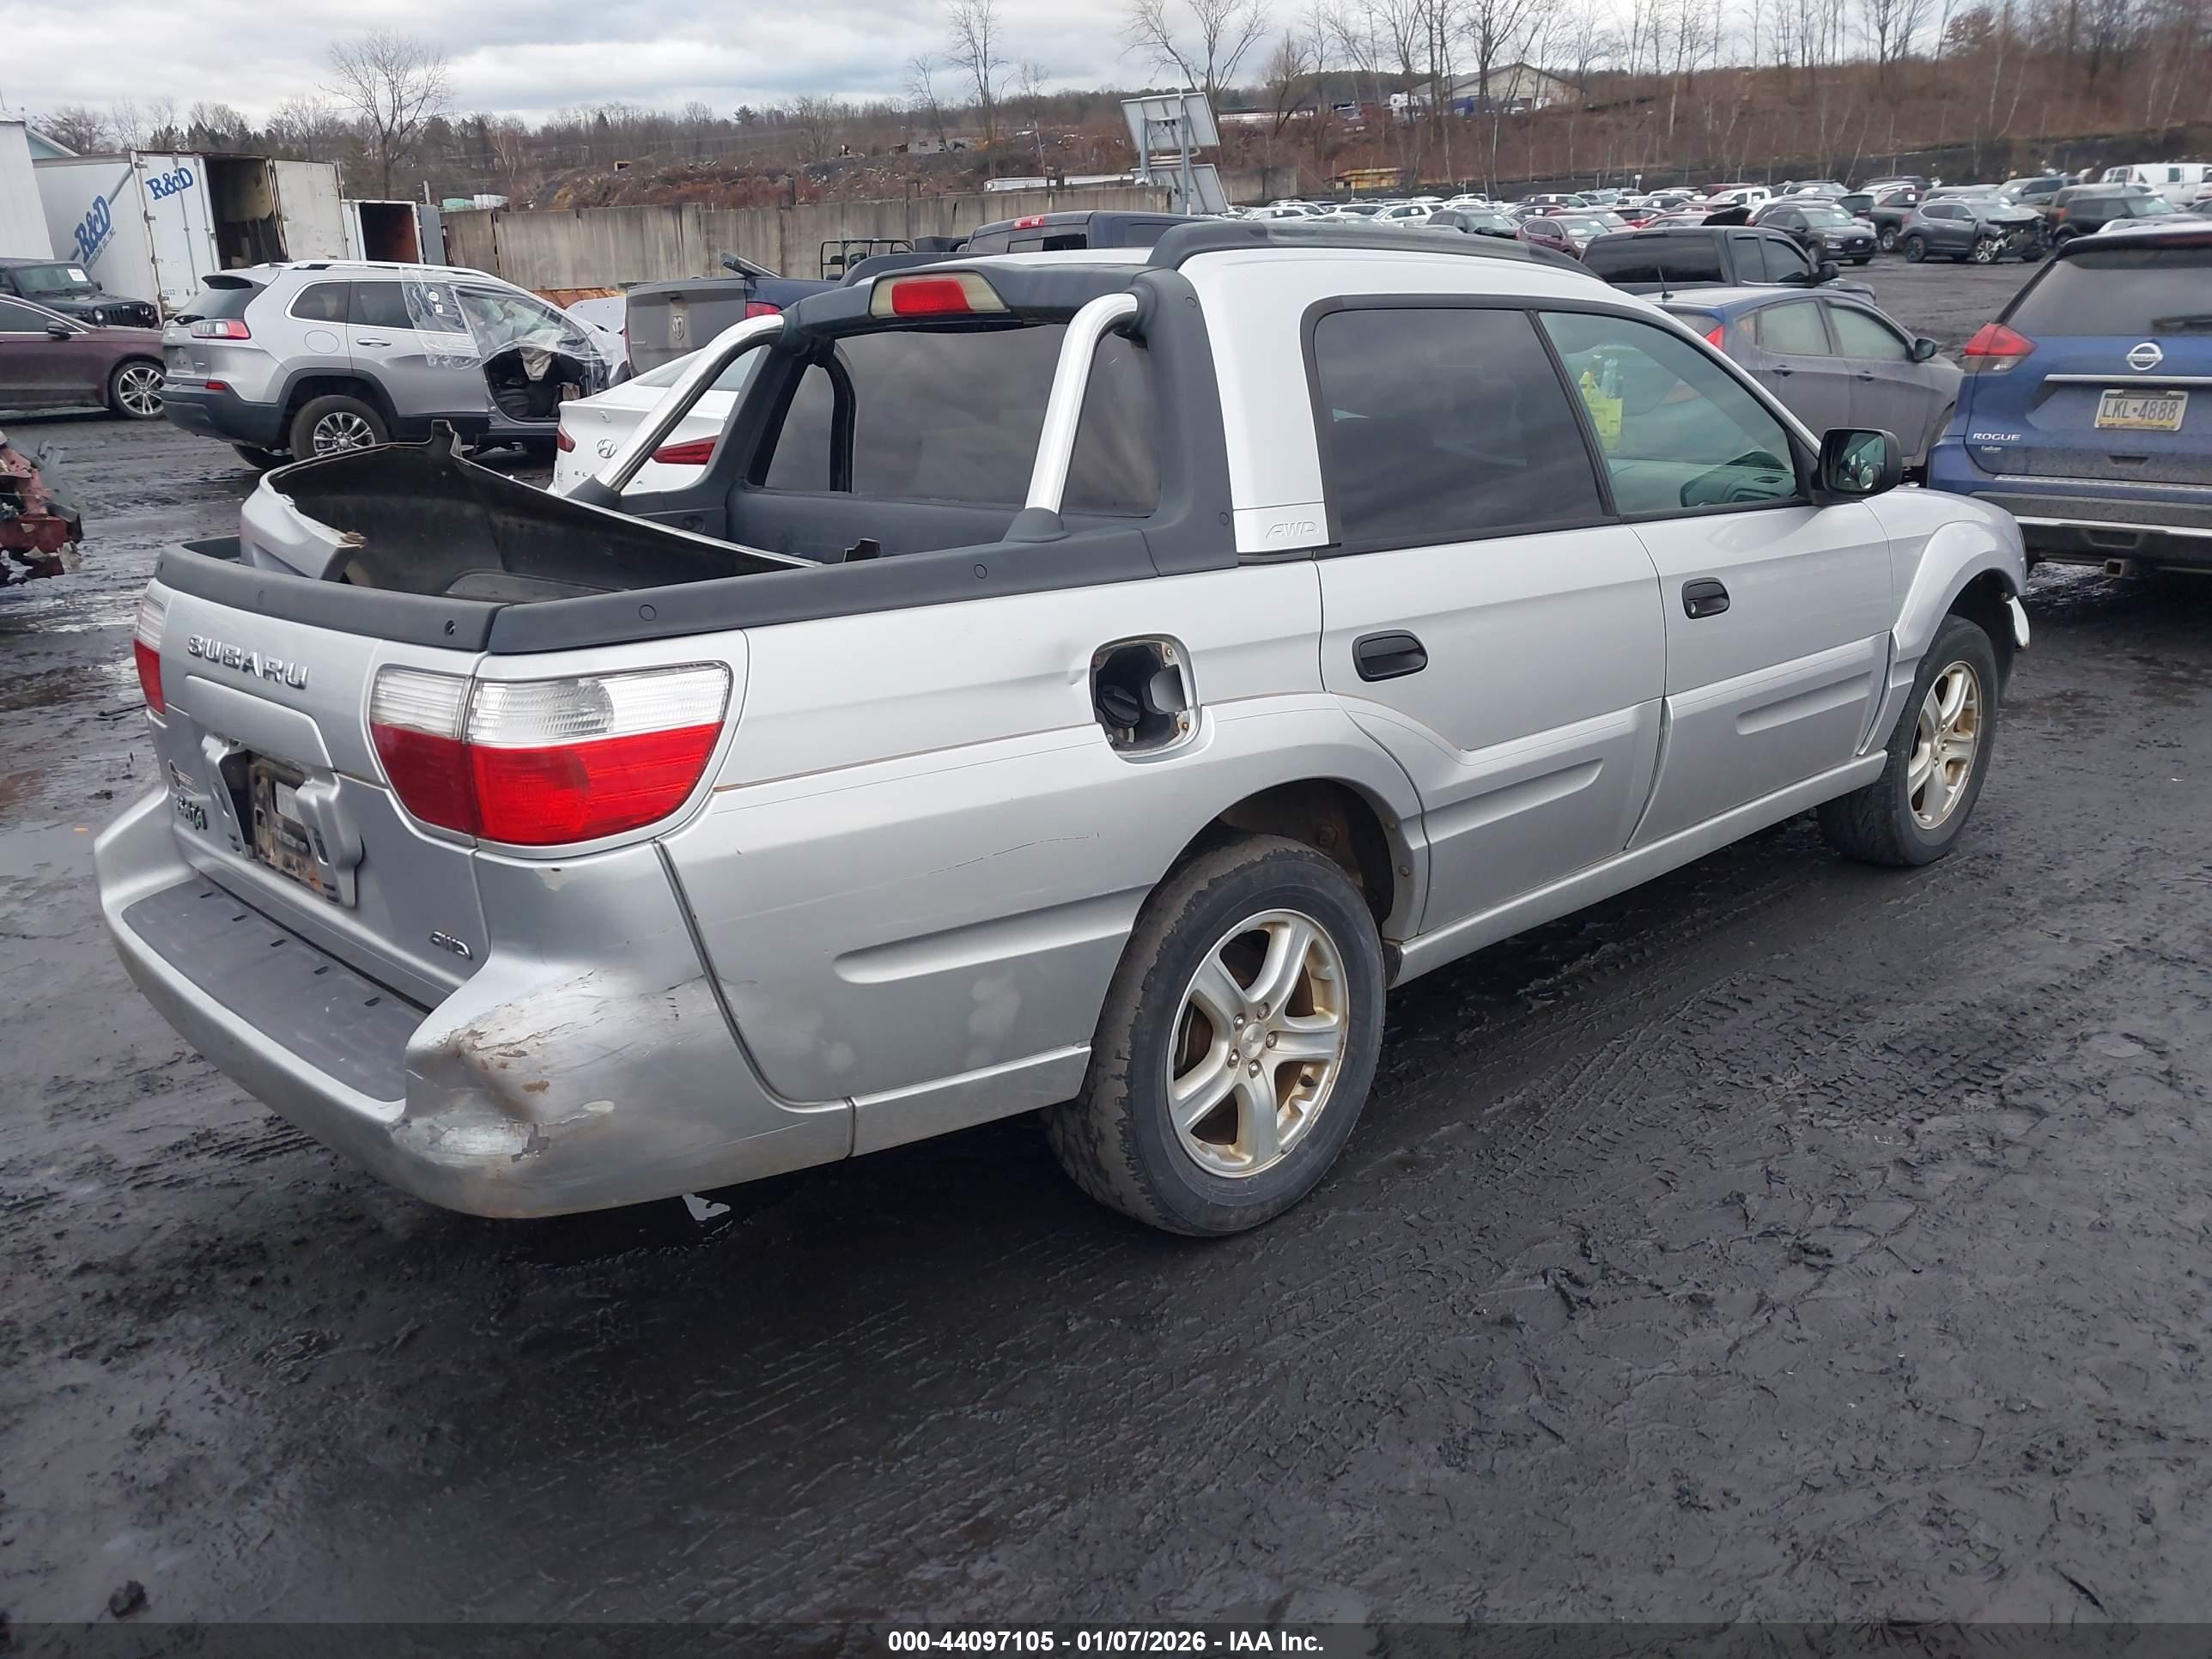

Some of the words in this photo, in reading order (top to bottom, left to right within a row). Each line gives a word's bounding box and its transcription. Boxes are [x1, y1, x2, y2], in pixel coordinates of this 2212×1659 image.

[145, 167, 194, 201] R&D
[74, 195, 111, 264] R&D
[1972, 433, 2022, 441] ROGUE
[1265, 520, 1321, 538] AWD
[187, 634, 310, 690] SUBARU
